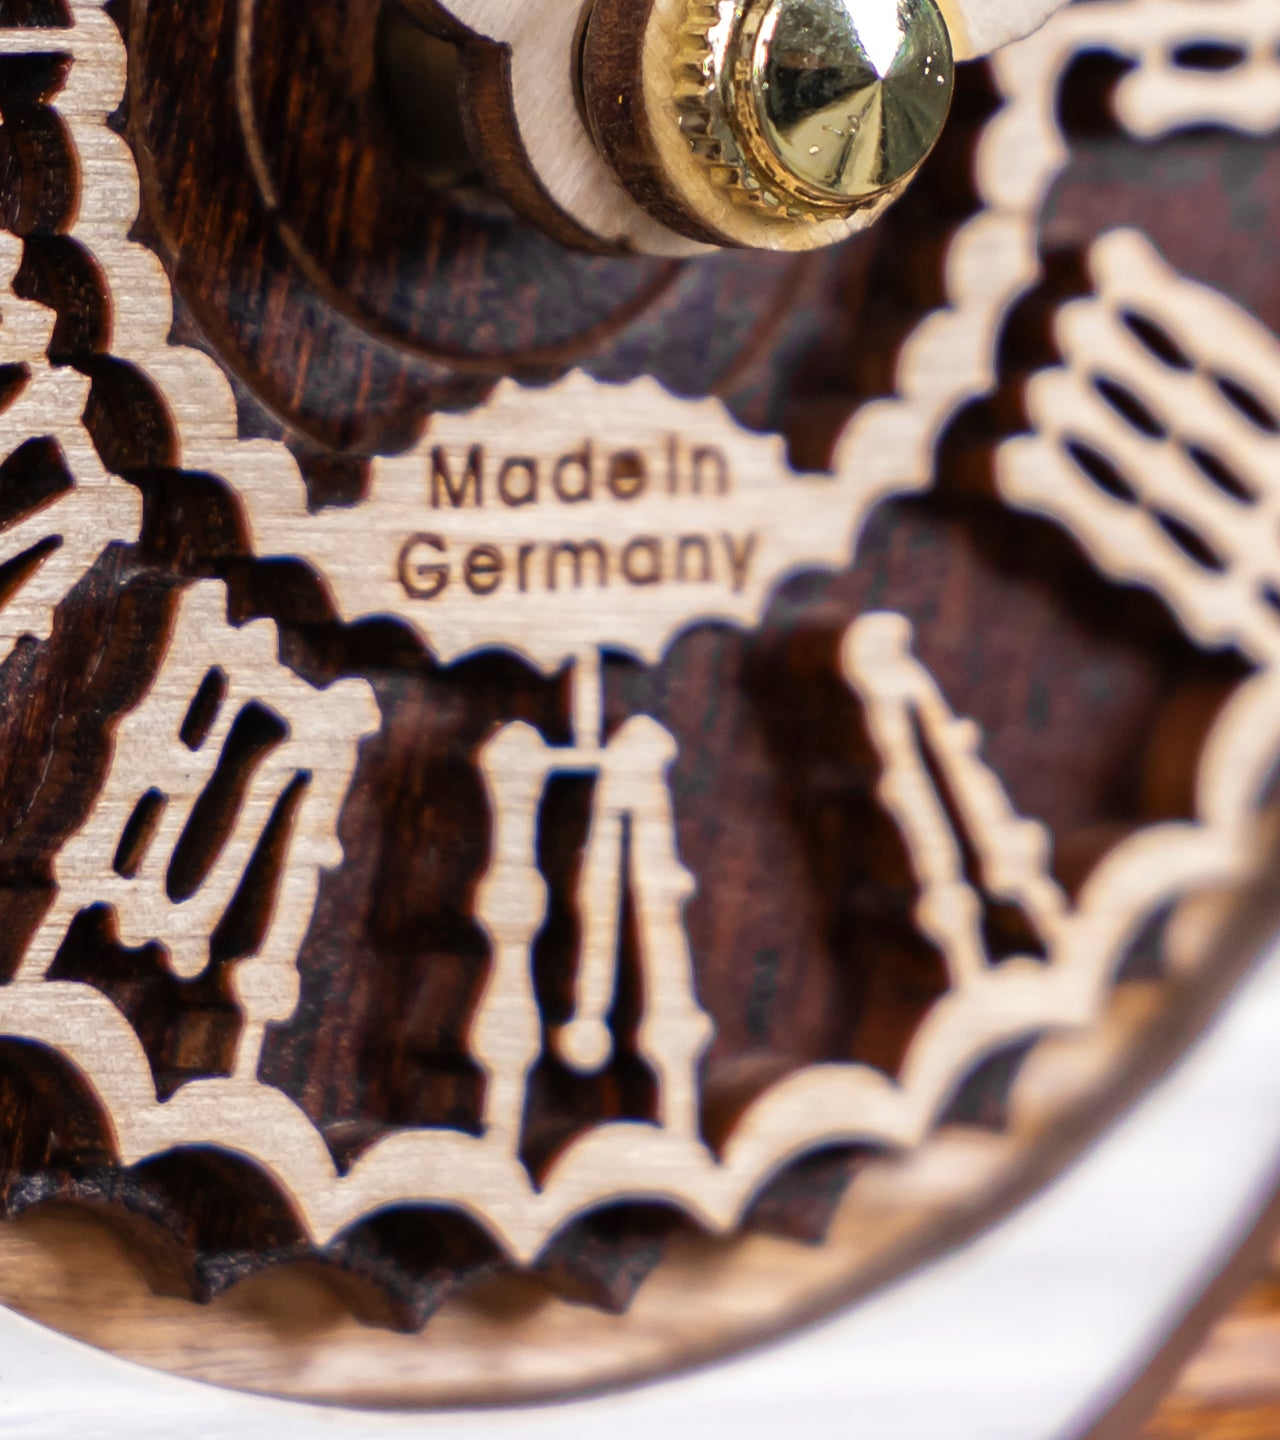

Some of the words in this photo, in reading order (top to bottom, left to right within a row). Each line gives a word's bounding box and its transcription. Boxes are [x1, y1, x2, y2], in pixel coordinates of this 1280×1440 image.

[430, 439, 649, 510] Made
[396, 529, 757, 602] Germany
[468, 714, 716, 1085] VI
